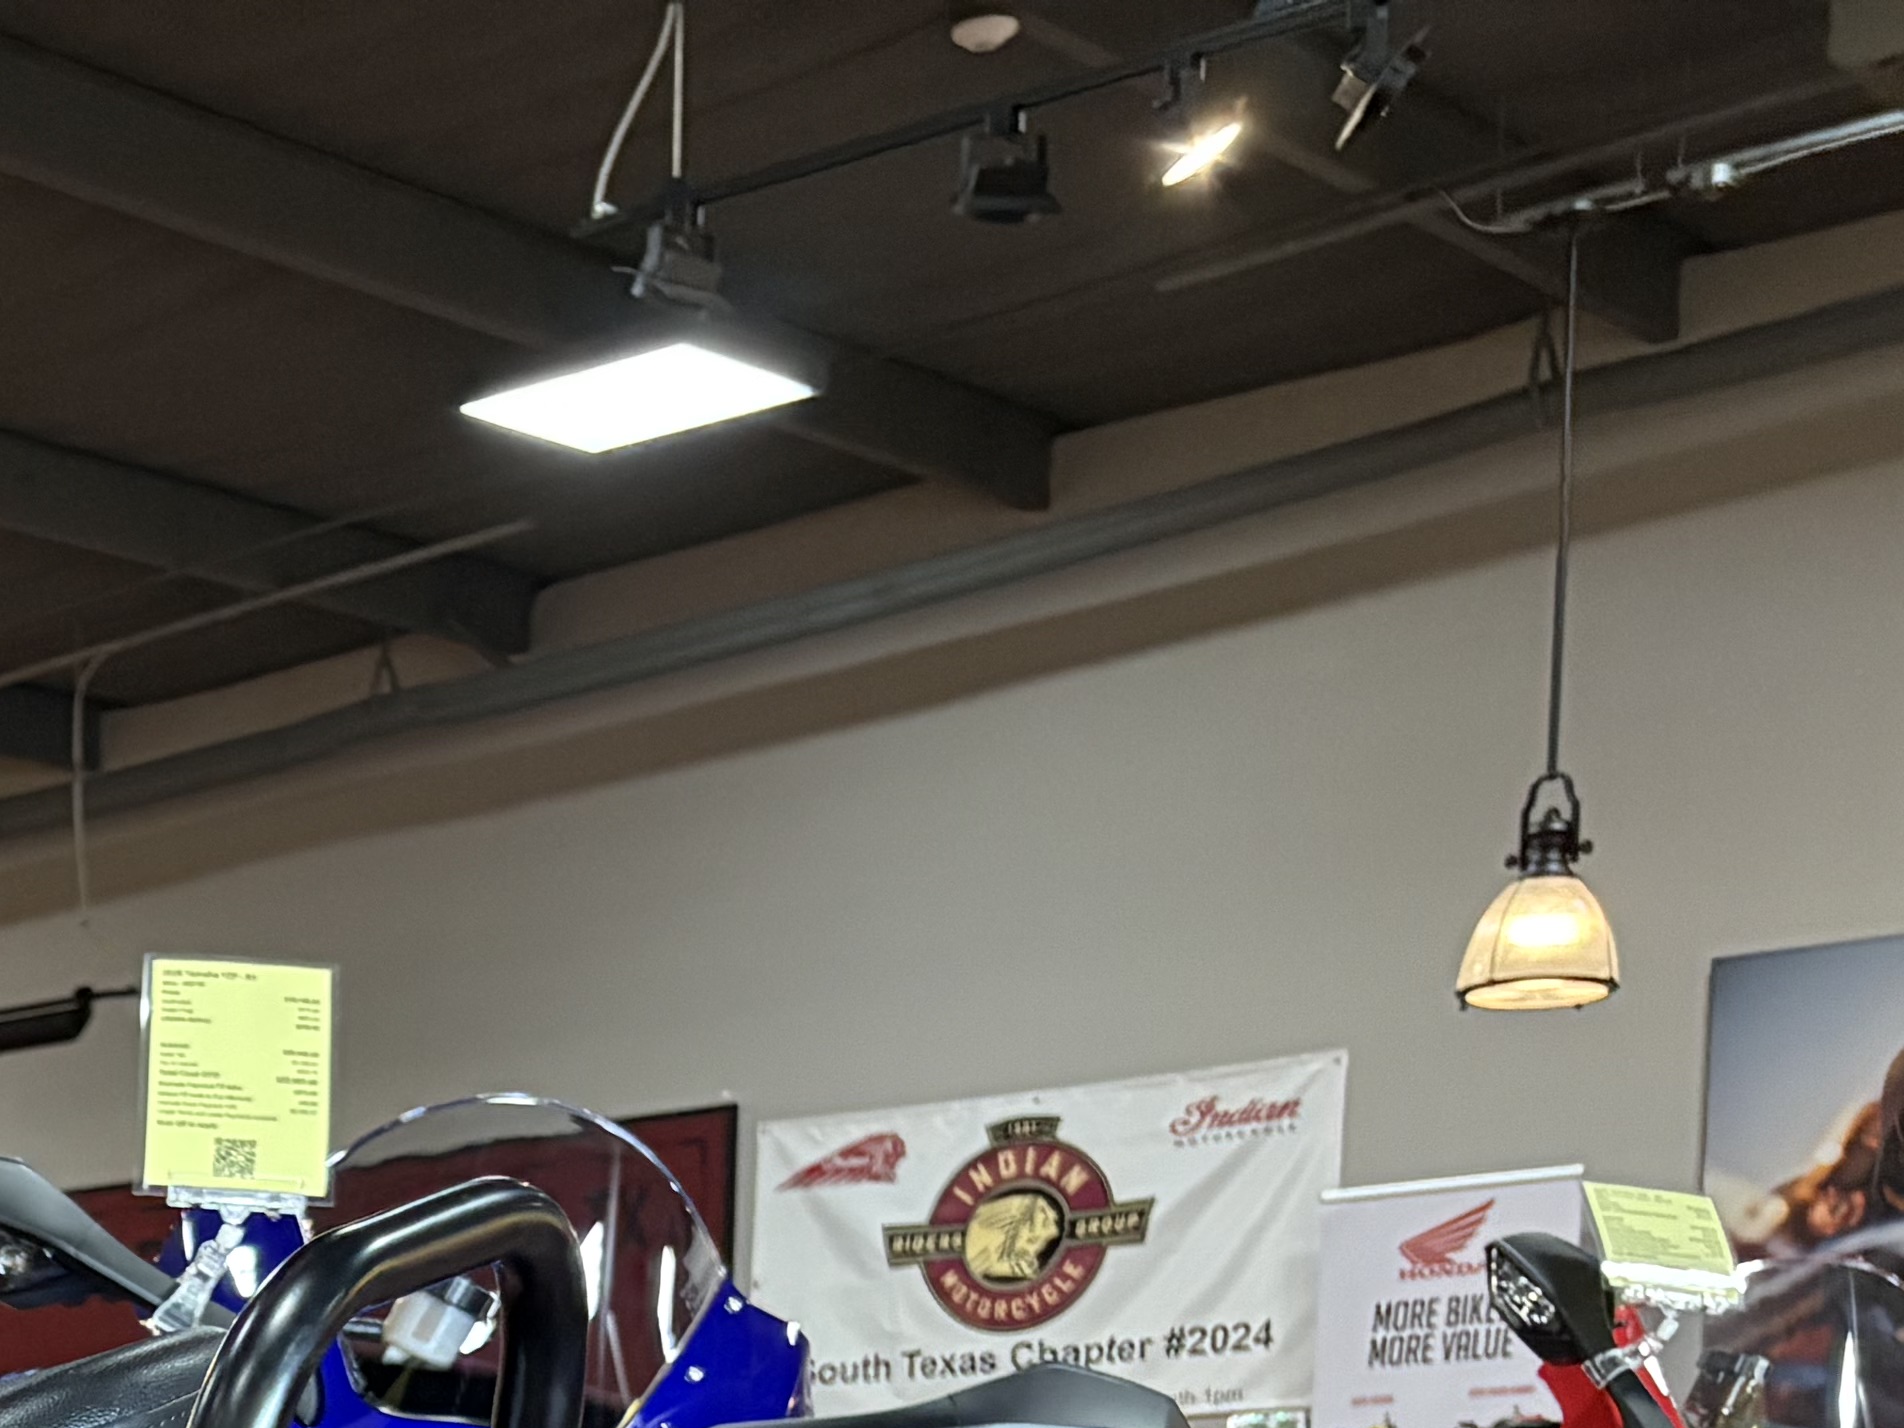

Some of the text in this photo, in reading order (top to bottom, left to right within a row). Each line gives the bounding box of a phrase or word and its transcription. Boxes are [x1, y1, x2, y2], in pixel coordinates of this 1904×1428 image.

[1169, 1095, 1301, 1136] Indian
[953, 1146, 1090, 1205] INDIAN
[893, 1212, 1141, 1251] RIDERS GROUP
[941, 1259, 1086, 1321] MOTORCYCLE
[1398, 1262, 1488, 1281] HONDA
[1371, 1298, 1440, 1333] MORE
[902, 1348, 996, 1381] Texas
[1010, 1333, 1153, 1371] Chapter
[1165, 1318, 1275, 1359] #2024
[1367, 1327, 1513, 1368] MORE VALUE
